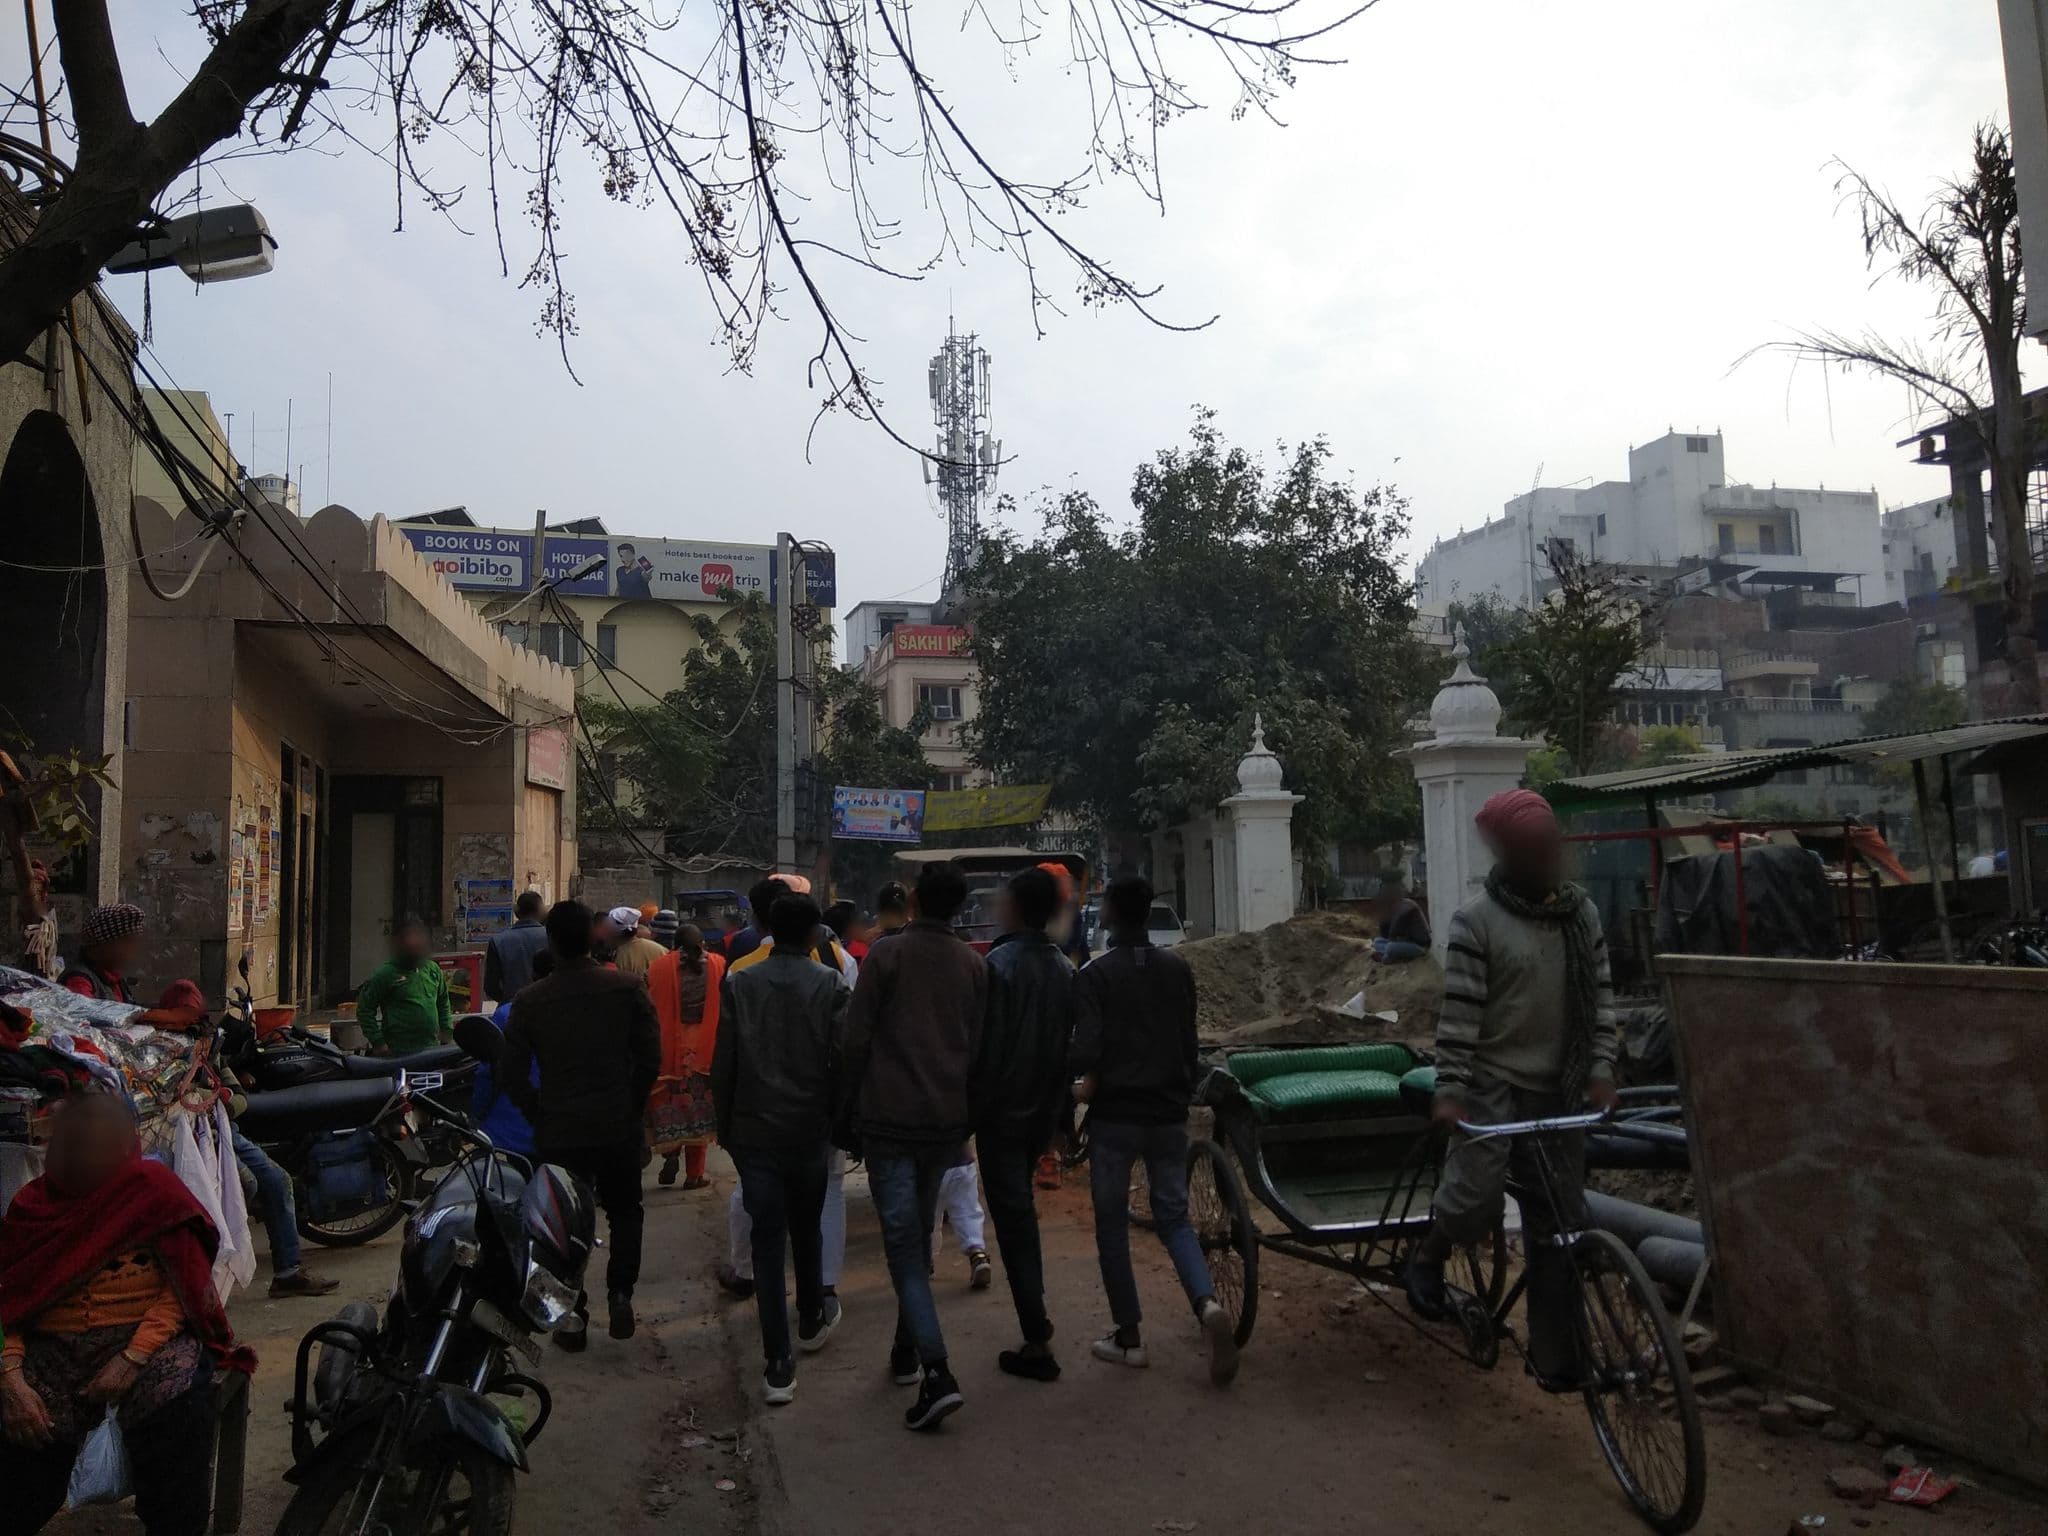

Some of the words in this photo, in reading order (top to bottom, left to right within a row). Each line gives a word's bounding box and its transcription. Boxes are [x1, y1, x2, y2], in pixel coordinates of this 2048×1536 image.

[425, 535, 469, 549] BOOK
[473, 537, 492, 551] US
[497, 539, 520, 553] ON
[665, 549, 691, 558] Hotels
[693, 551, 710, 559] best
[713, 553, 743, 561] booked
[433, 557, 513, 577] goibibo
[493, 575, 513, 583] .com
[659, 570, 699, 583] make
[735, 573, 761, 588] trip
[898, 634, 943, 651] SAKHI
